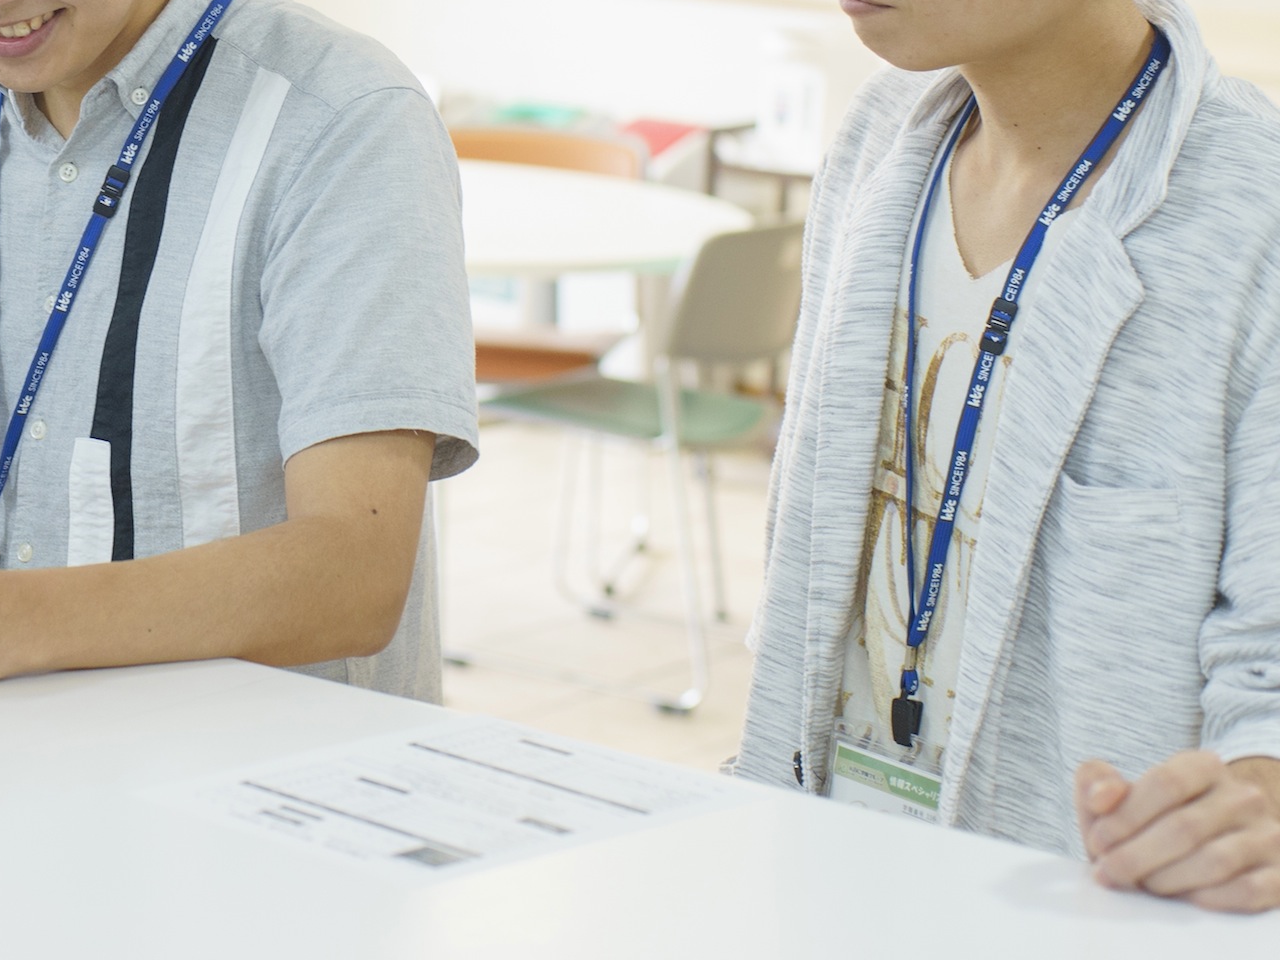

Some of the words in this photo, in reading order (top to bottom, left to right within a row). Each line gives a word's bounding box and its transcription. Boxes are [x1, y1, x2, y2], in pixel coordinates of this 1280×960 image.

[195, 3, 224, 42] SINCE1984
[1131, 58, 1161, 100] SINCE1984
[133, 99, 161, 141] SINCE1984
[1056, 158, 1093, 203] SINCE1984
[67, 246, 91, 289] SINCE1984
[1004, 268, 1025, 302] CE1984
[27, 351, 50, 393] SINCE1984
[948, 450, 968, 496] SINCE1984
[925, 562, 944, 608] SINCE1984
